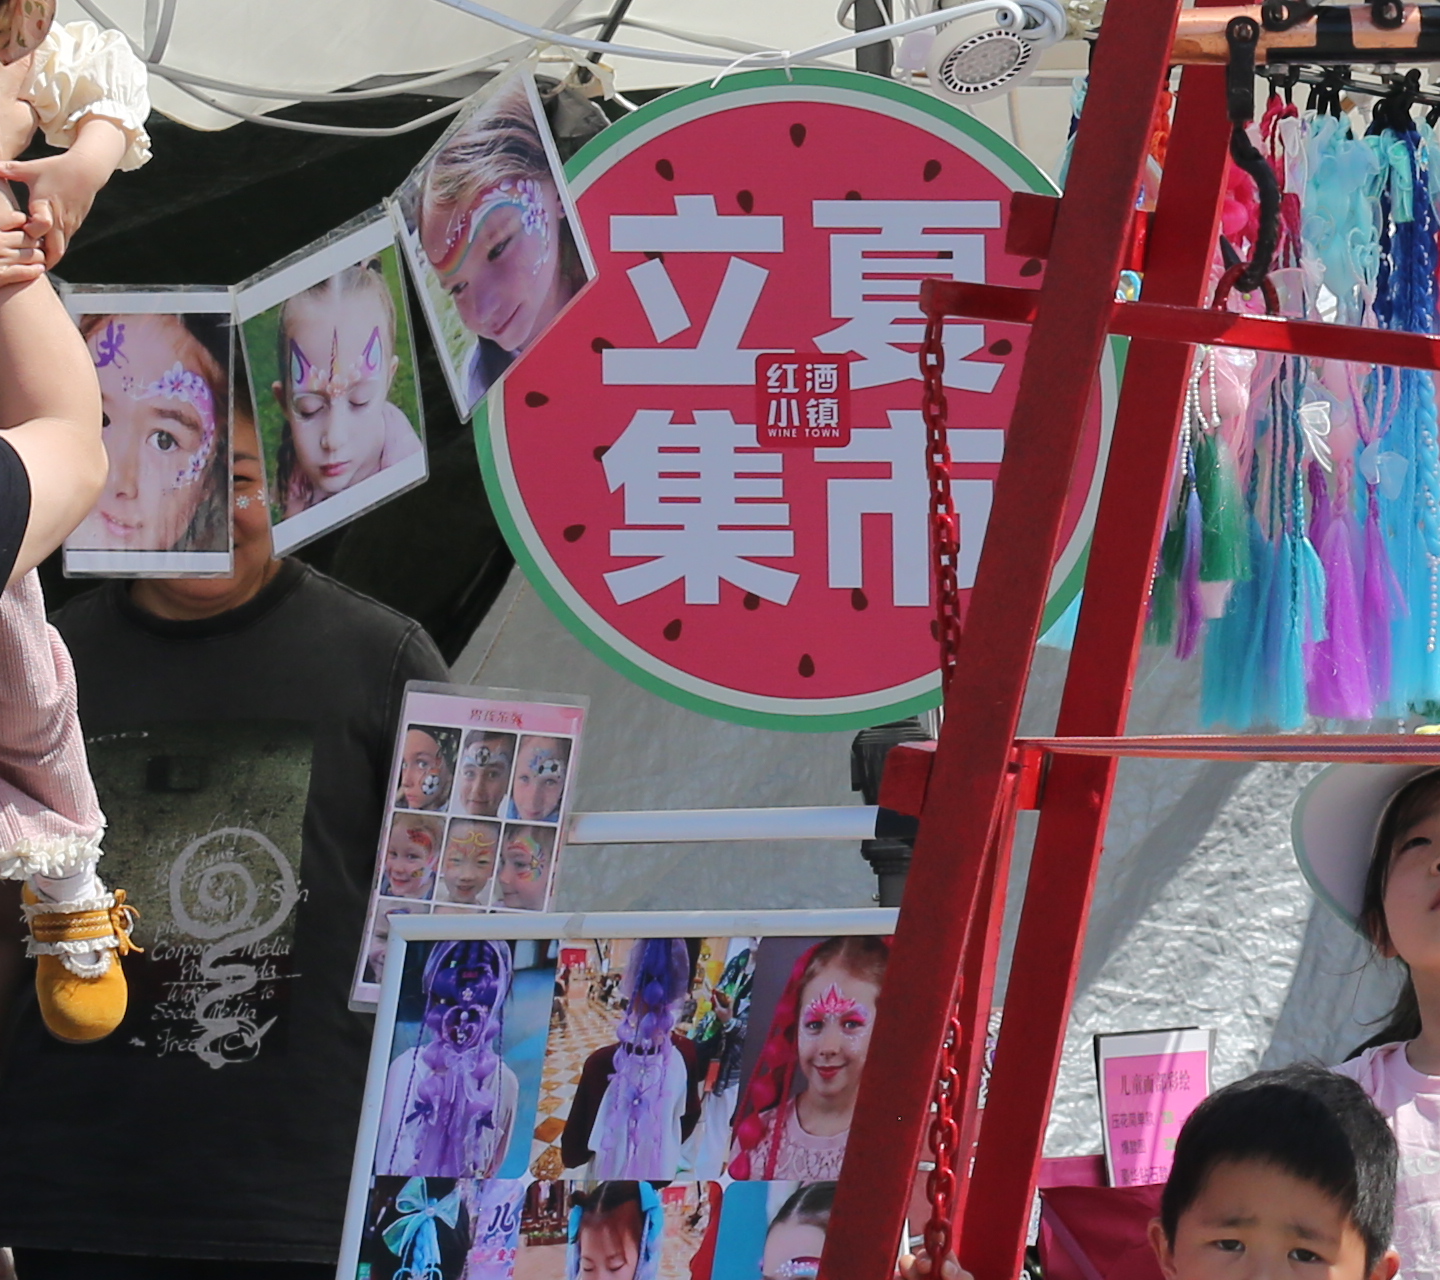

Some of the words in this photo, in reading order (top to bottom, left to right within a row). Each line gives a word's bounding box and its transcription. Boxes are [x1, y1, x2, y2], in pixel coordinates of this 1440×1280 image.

[602, 195, 1006, 394] 立夏
[766, 363, 839, 394] 红酒
[767, 397, 839, 428] 小镇
[767, 428, 798, 438] WINE
[804, 428, 840, 438] TOWN
[601, 410, 1006, 608] 集市
[242, 936, 291, 959] Media
[151, 1001, 198, 1020] Socia
